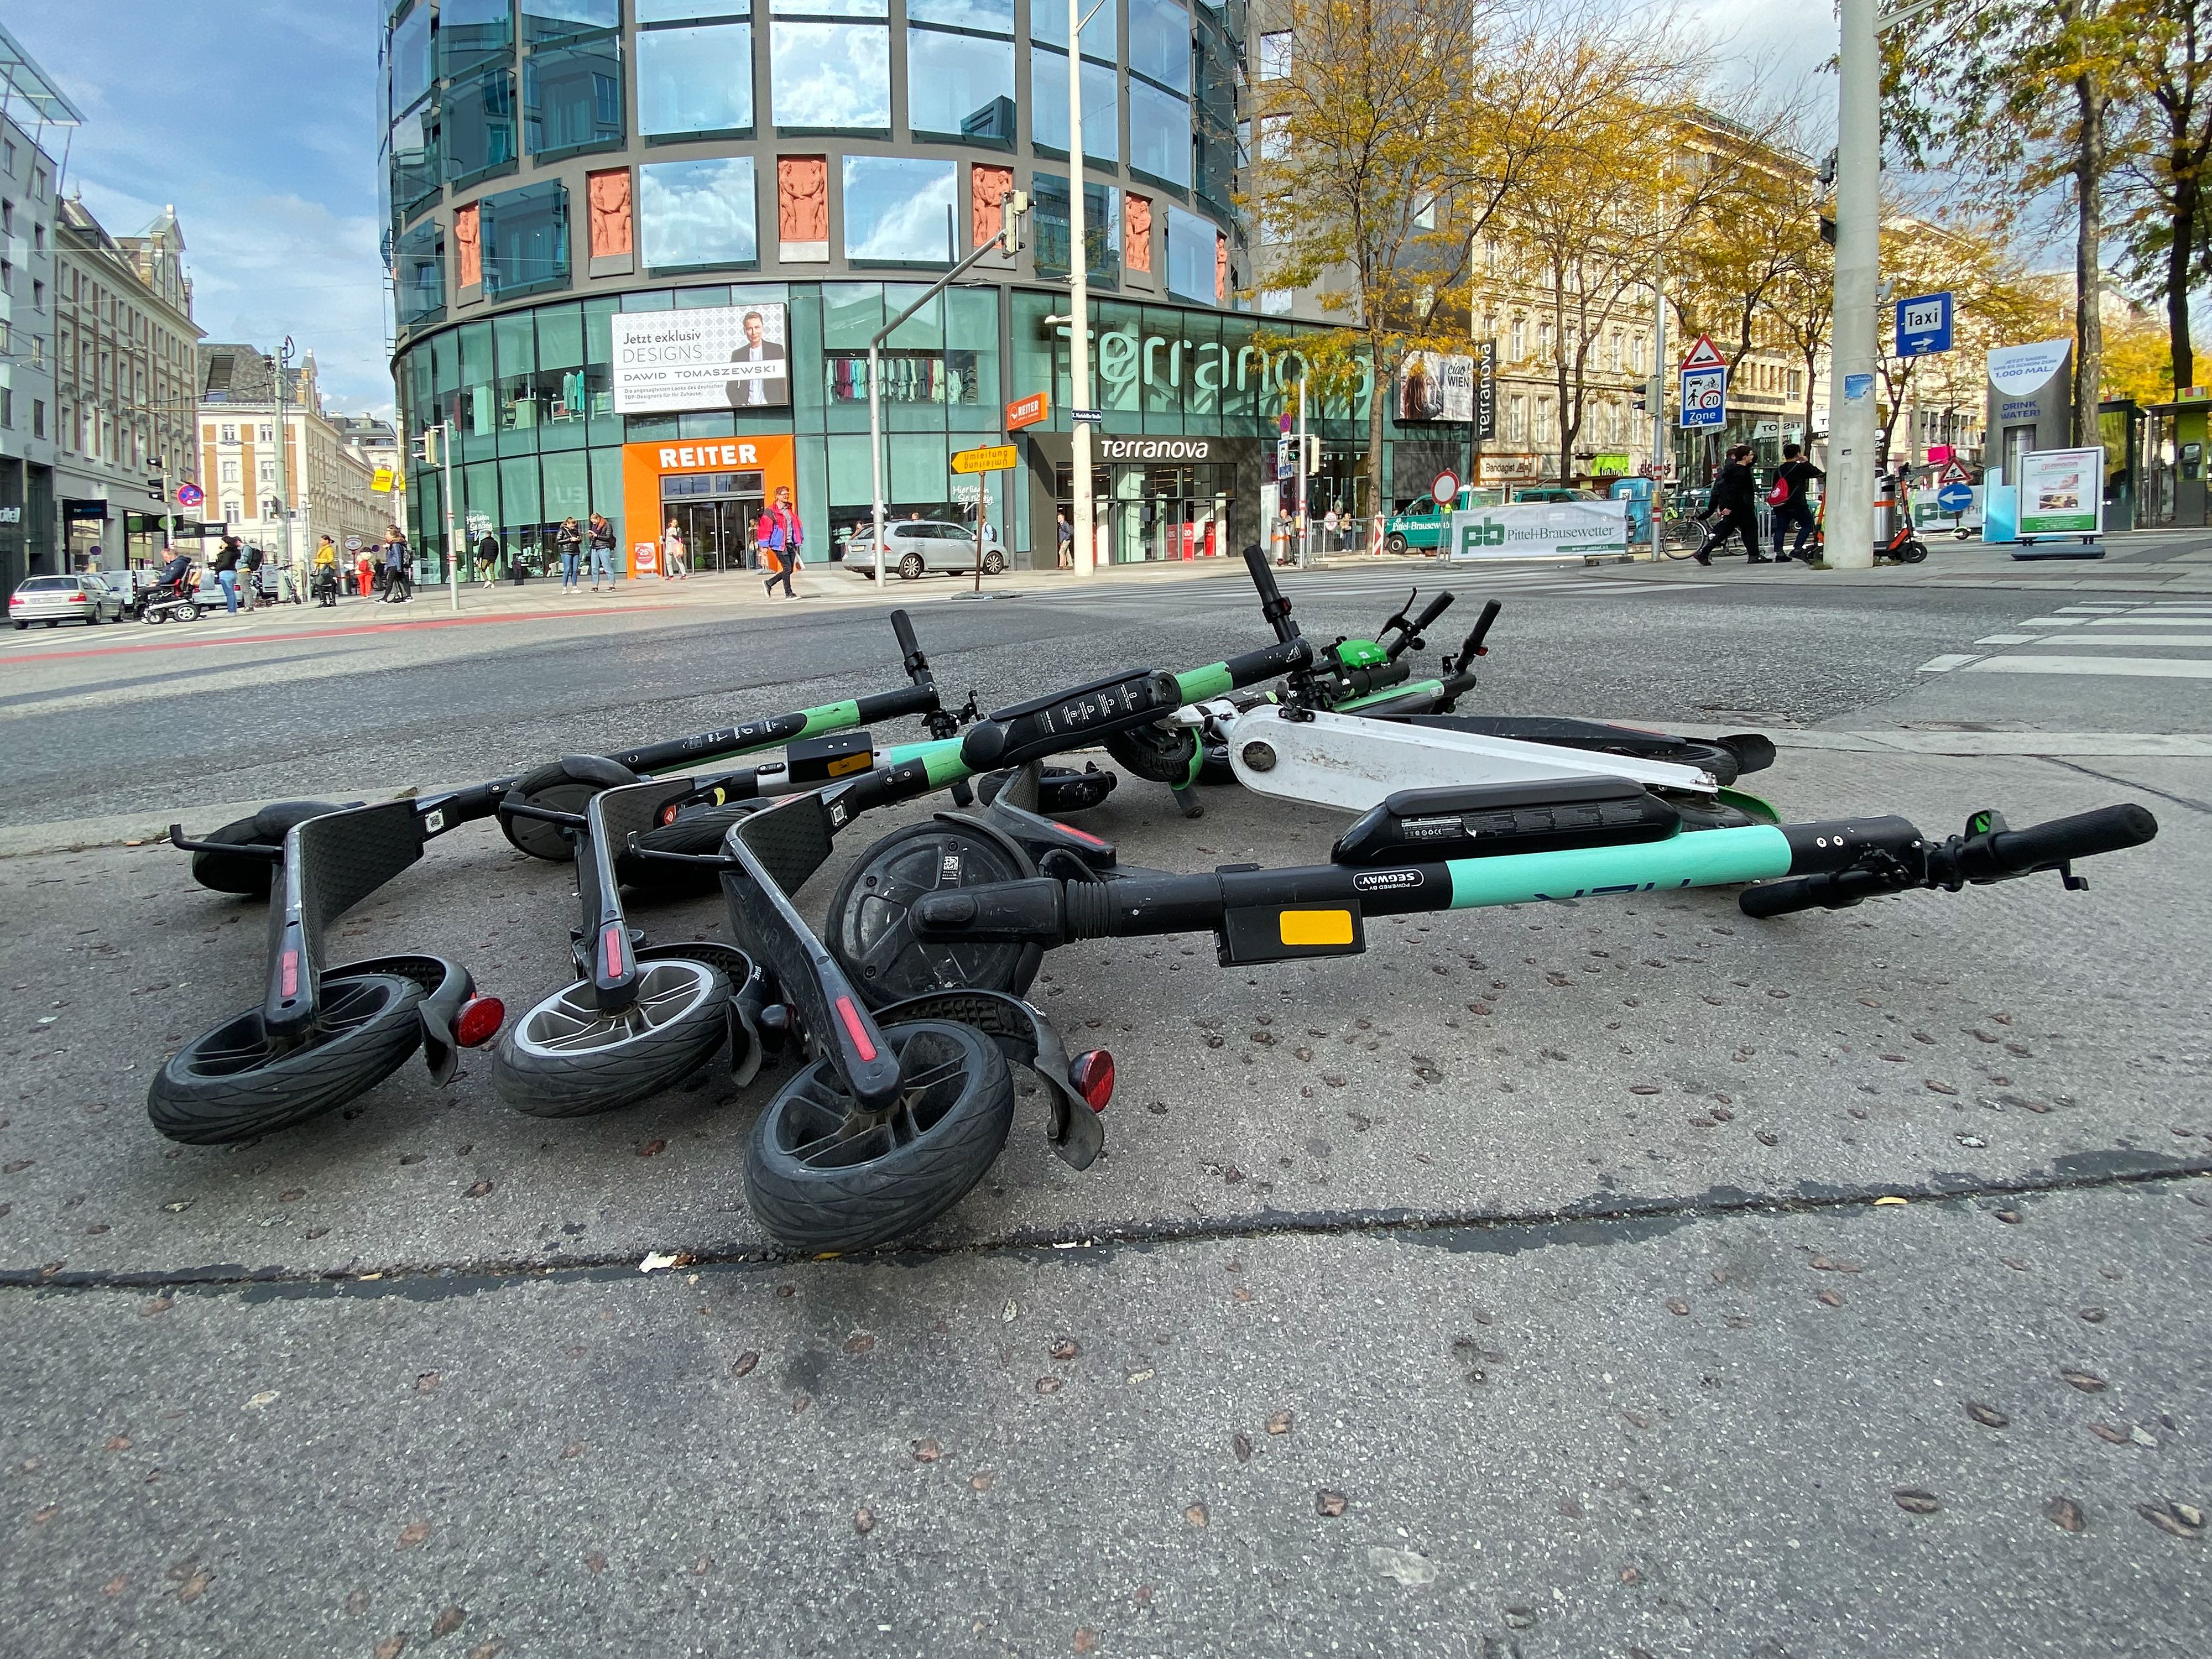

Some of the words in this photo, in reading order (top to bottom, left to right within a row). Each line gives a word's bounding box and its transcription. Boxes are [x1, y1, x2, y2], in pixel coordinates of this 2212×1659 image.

[1907, 308, 1938, 327] Taxi
[624, 332, 651, 345] Jetzt
[655, 330, 701, 343] exklusiv
[623, 345, 702, 363] DESIGNS
[1057, 326, 1375, 398] Terranoa
[1447, 362, 1470, 376] ciao!
[624, 372, 667, 382] DAWID
[675, 365, 775, 378] TOMASZEWSKI
[1996, 369, 2023, 378] 1.000
[2025, 366, 2053, 374] MAL:
[1447, 375, 1469, 388] WIEN
[1480, 343, 1491, 436] Terranova
[1705, 395, 1718, 406] 20
[2002, 400, 2037, 411] DRINK
[1018, 400, 1039, 417] REITER
[2001, 409, 2041, 420] WATER!
[1689, 411, 1716, 421] Zone
[659, 444, 758, 469] REITER
[964, 450, 1008, 461] Umleitung
[1101, 440, 1209, 460] Terranova
[964, 458, 1008, 469] Umleitung
[1485, 463, 1515, 474] Bandagist
[1507, 525, 1614, 541] Pittel+Brausewetter
[1362, 873, 1415, 885] SEGWAY
